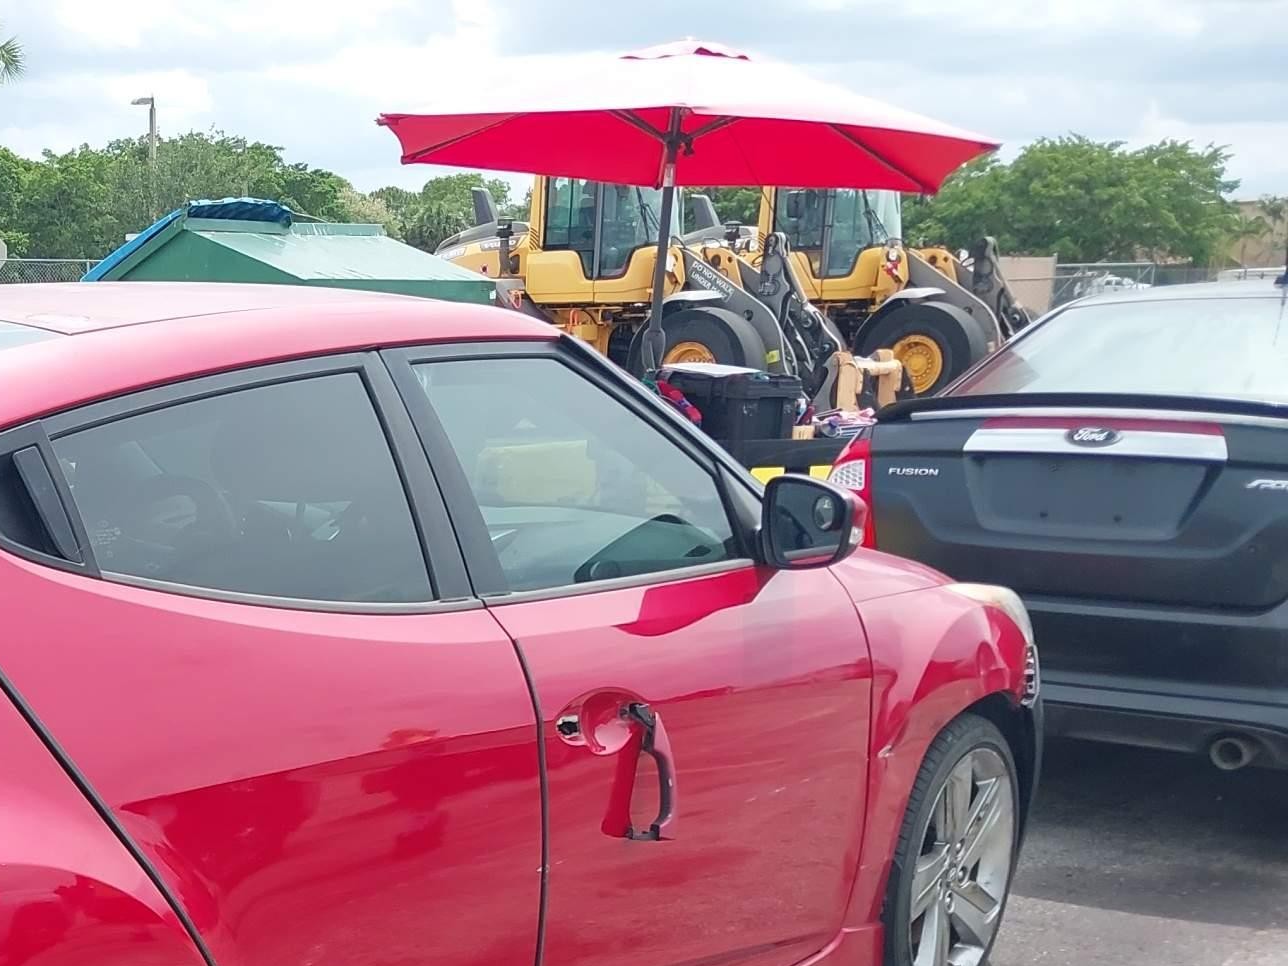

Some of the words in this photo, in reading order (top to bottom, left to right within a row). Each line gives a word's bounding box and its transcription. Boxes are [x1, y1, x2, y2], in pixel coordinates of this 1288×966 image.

[692, 261, 703, 271] DO
[1073, 427, 1108, 441] Ford
[888, 467, 939, 476] FUSION
